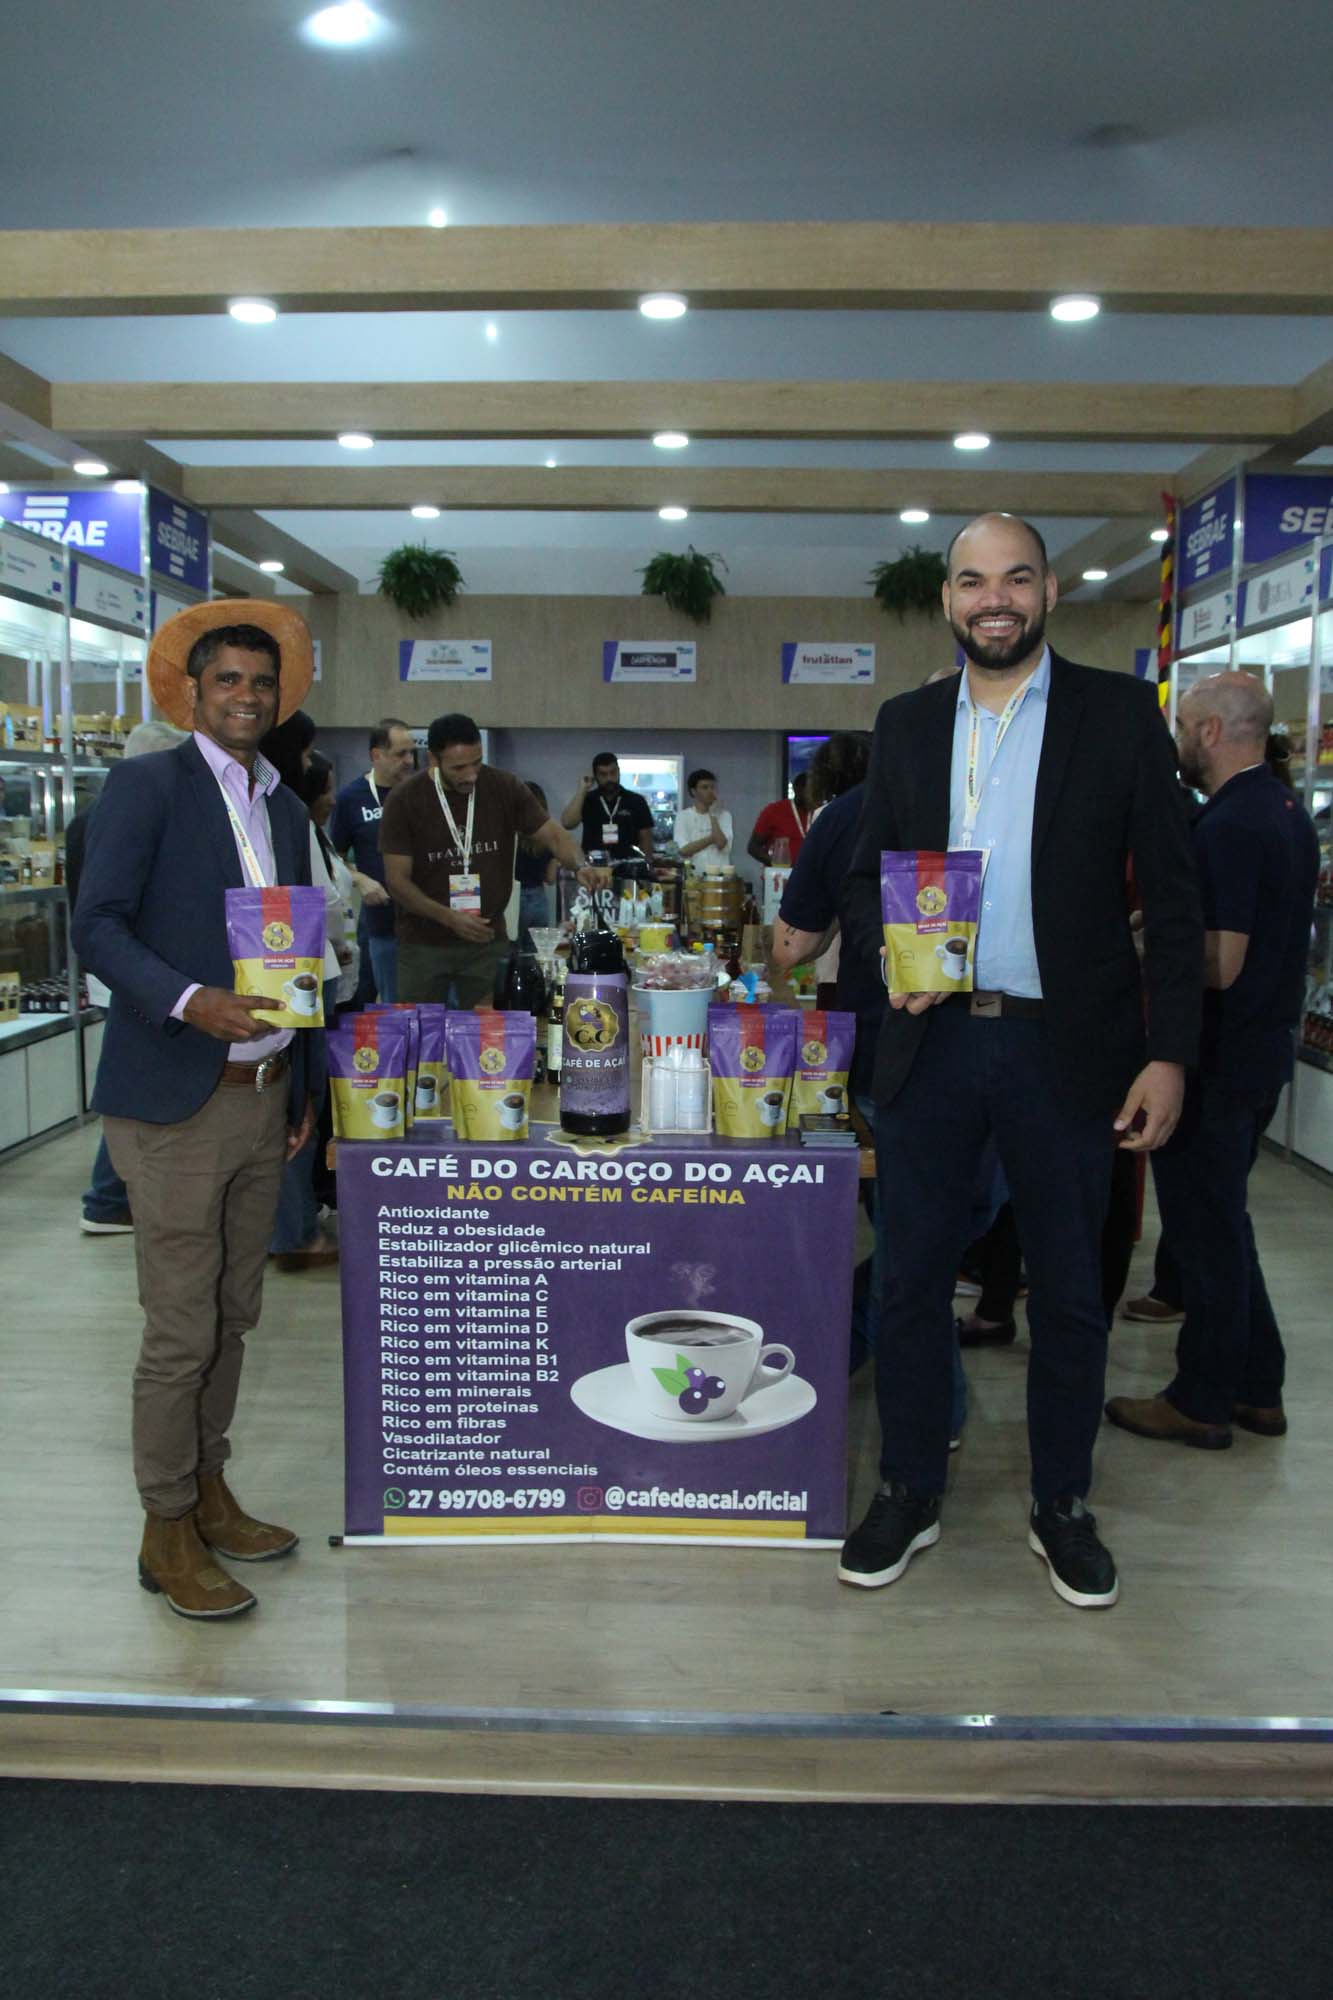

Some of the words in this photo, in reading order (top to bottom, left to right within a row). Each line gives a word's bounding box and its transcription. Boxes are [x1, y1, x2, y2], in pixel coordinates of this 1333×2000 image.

[585, 1059, 601, 1068] DE
[371, 1153, 459, 1178] CAFÉ
[470, 1158, 518, 1180] DO
[528, 1159, 673, 1185] CAROÇO
[684, 1162, 732, 1183] DO
[742, 1163, 825, 1189] AÇAI
[447, 1182, 503, 1202] NÃO
[510, 1183, 623, 1204] CONTÉM
[631, 1185, 746, 1205] CAFEÍNA
[377, 1205, 490, 1220] Antioxidante
[378, 1221, 434, 1236] Reduz
[438, 1225, 449, 1236] a
[453, 1223, 546, 1237] obesidade
[378, 1237, 494, 1253] Estabilizador
[498, 1240, 584, 1256] glicêmico
[589, 1242, 651, 1255] natural
[378, 1254, 464, 1269] Estabiliza
[468, 1259, 479, 1269] a
[484, 1253, 556, 1272] pressão
[560, 1257, 623, 1271] arterial
[379, 1270, 419, 1284] Rico
[423, 1275, 450, 1285] em
[455, 1272, 530, 1286] vitamina
[534, 1273, 549, 1286] A
[379, 1286, 419, 1301] Rico
[423, 1291, 450, 1301] em
[455, 1289, 531, 1302] vitamina
[535, 1289, 549, 1302] C
[380, 1303, 420, 1317] Rico
[423, 1307, 451, 1318] em
[455, 1305, 531, 1318] vitamina
[535, 1305, 548, 1318] E
[380, 1319, 420, 1333] Rico
[423, 1323, 451, 1334] em
[455, 1321, 531, 1334] vitamina
[535, 1321, 549, 1334] D
[380, 1335, 420, 1349] Rico
[424, 1340, 451, 1350] em
[455, 1337, 531, 1350] vitamina
[535, 1337, 549, 1350] K
[380, 1351, 420, 1366] Rico
[424, 1356, 451, 1366] em
[455, 1353, 531, 1366] vitamina
[536, 1353, 557, 1366] B1
[381, 1367, 421, 1381] Rico
[424, 1372, 452, 1382] em
[456, 1369, 531, 1382] vitamina
[536, 1369, 559, 1382] B2
[381, 1383, 421, 1397] Rico
[424, 1388, 452, 1398] em
[456, 1385, 532, 1398] minerais
[382, 1399, 421, 1413] Rico
[425, 1403, 452, 1414] em
[382, 1415, 421, 1429] Rico
[425, 1419, 452, 1430] em
[456, 1416, 508, 1430] fibras
[381, 1431, 502, 1445] Vasodilatador
[382, 1447, 485, 1461] Cicatrizante
[490, 1447, 550, 1460] natural
[382, 1462, 450, 1476] Contém
[454, 1463, 502, 1476] óleos
[506, 1463, 599, 1476] essenciais
[407, 1488, 434, 1509] 27
[438, 1488, 566, 1510] 99708-6799
